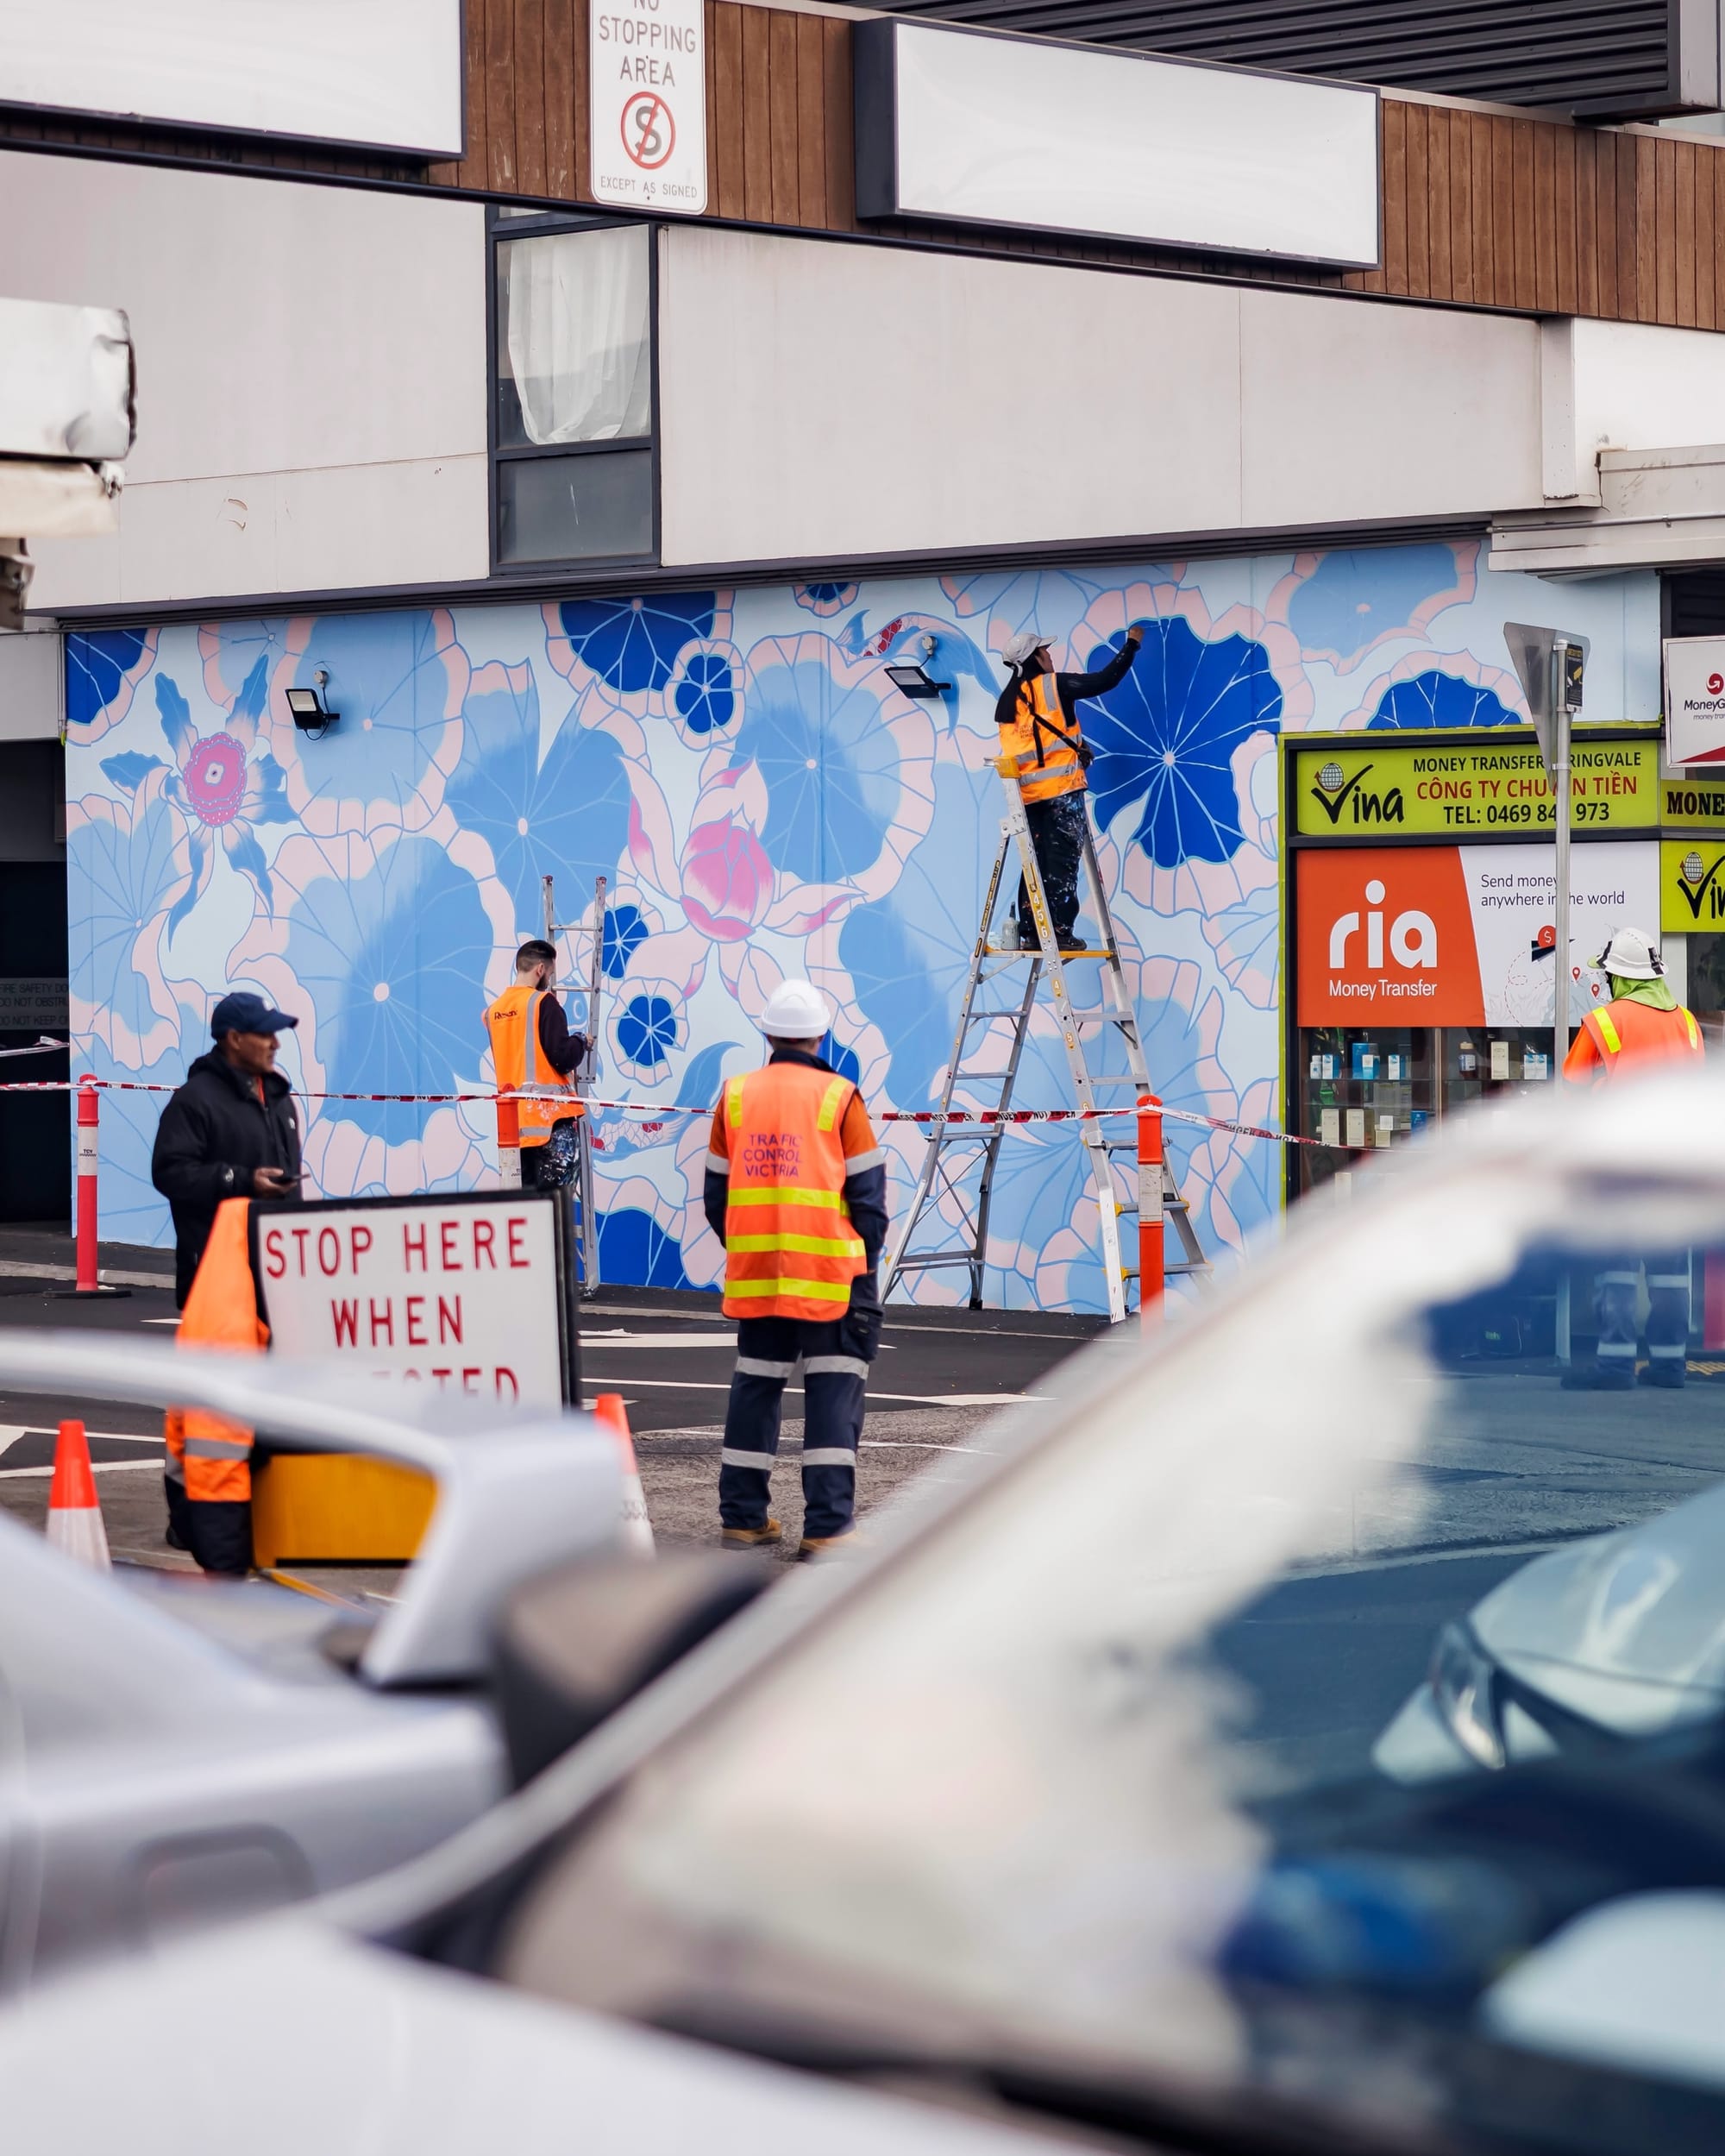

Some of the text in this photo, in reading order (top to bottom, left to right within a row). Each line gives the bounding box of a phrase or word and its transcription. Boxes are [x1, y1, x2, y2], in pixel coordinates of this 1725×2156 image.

[599, 15, 696, 53] STOPPING
[619, 55, 676, 87] AREA
[600, 175, 697, 198] EXCEPT AS SIGNED
[1414, 751, 1641, 772] MONEY TRANSFER RINGVALE
[1310, 764, 1405, 825] Vina
[1416, 776, 1472, 801] CÔNG
[1477, 780, 1501, 798] TY
[1593, 770, 1637, 795] TIỀN
[1443, 802, 1609, 824] TEL: 0469 84 973
[1667, 791, 1725, 815] MONE
[1481, 874, 1513, 888] Send
[1481, 893, 1544, 908] anywhere
[1569, 892, 1584, 905] he
[1588, 890, 1625, 904] world
[1329, 879, 1438, 969] ria
[1329, 978, 1438, 1001] Money Transfer
[265, 1217, 531, 1279] STOP HERE
[330, 1294, 464, 1348] WHEN
